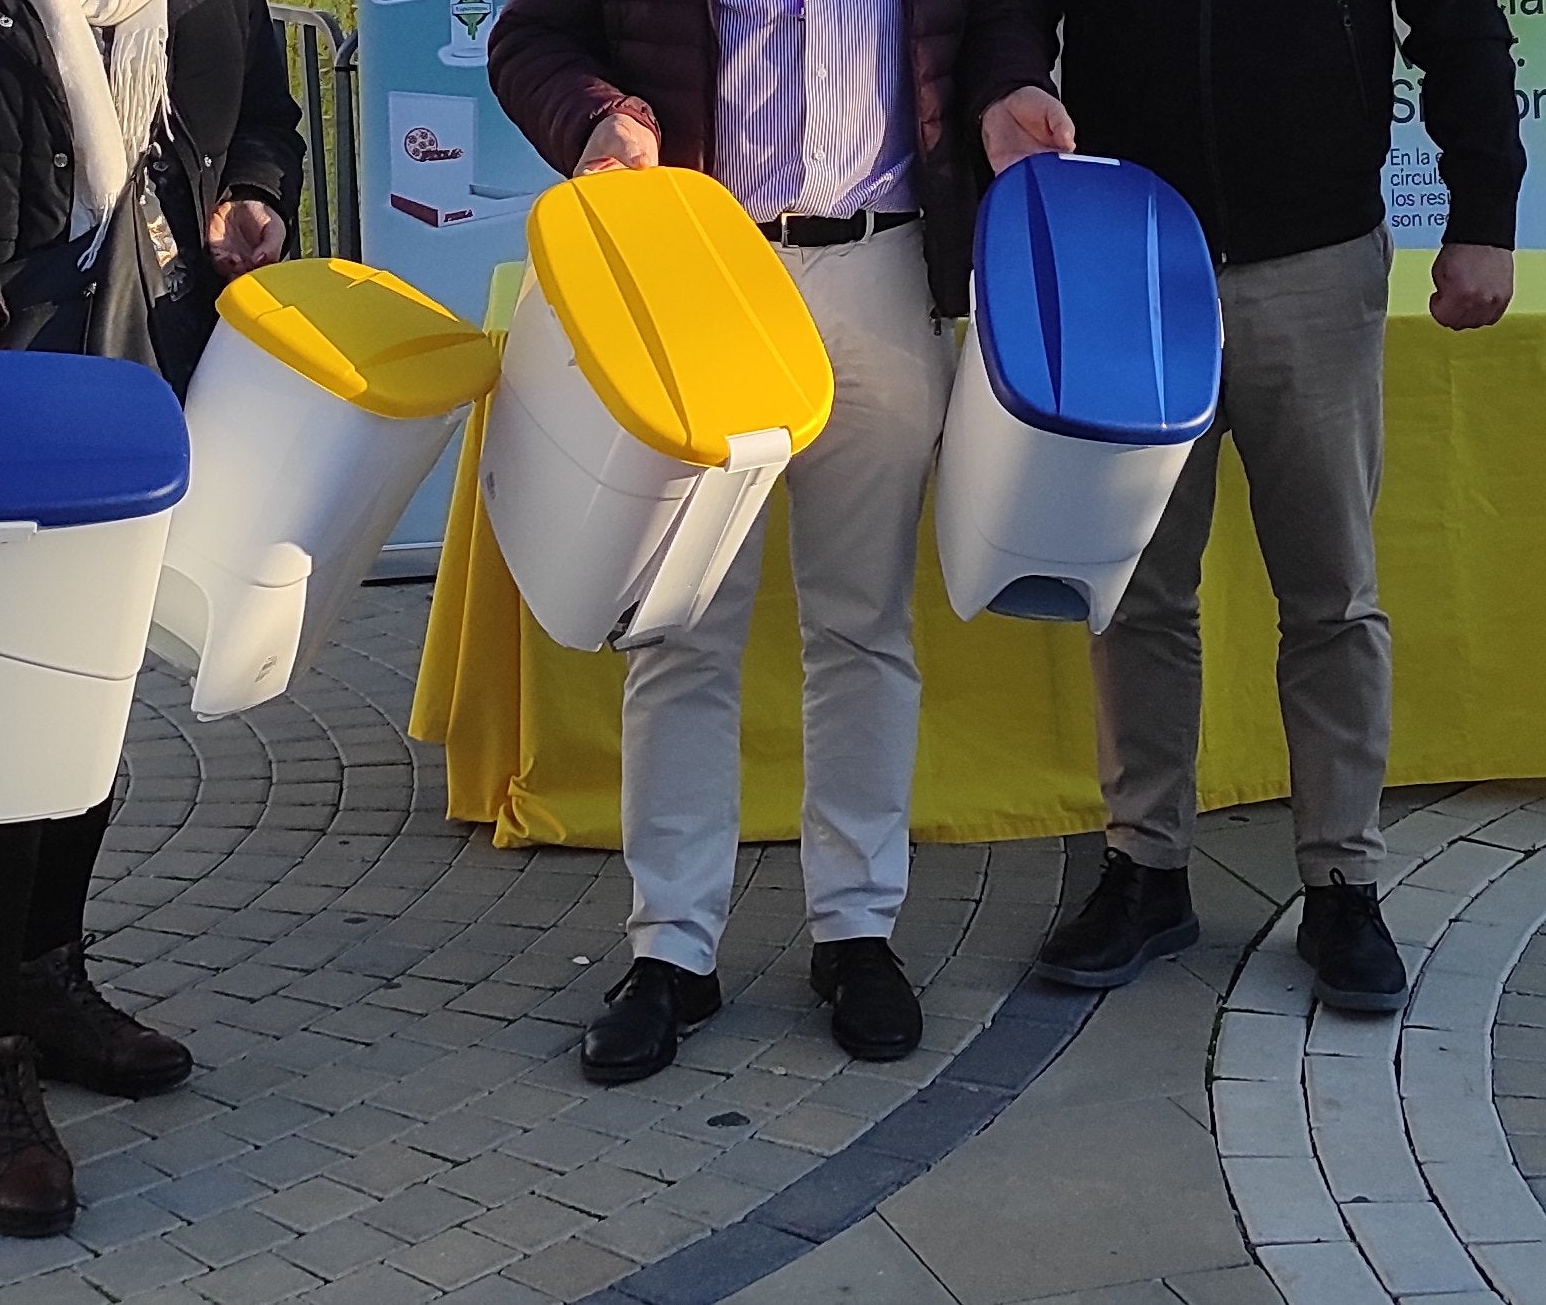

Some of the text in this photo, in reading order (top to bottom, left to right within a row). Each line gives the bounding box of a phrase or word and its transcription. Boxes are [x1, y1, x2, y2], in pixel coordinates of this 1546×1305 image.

[1390, 148, 1411, 166] En
[1416, 147, 1431, 166] la
[1391, 188, 1415, 207] los
[1391, 214, 1422, 227] son
